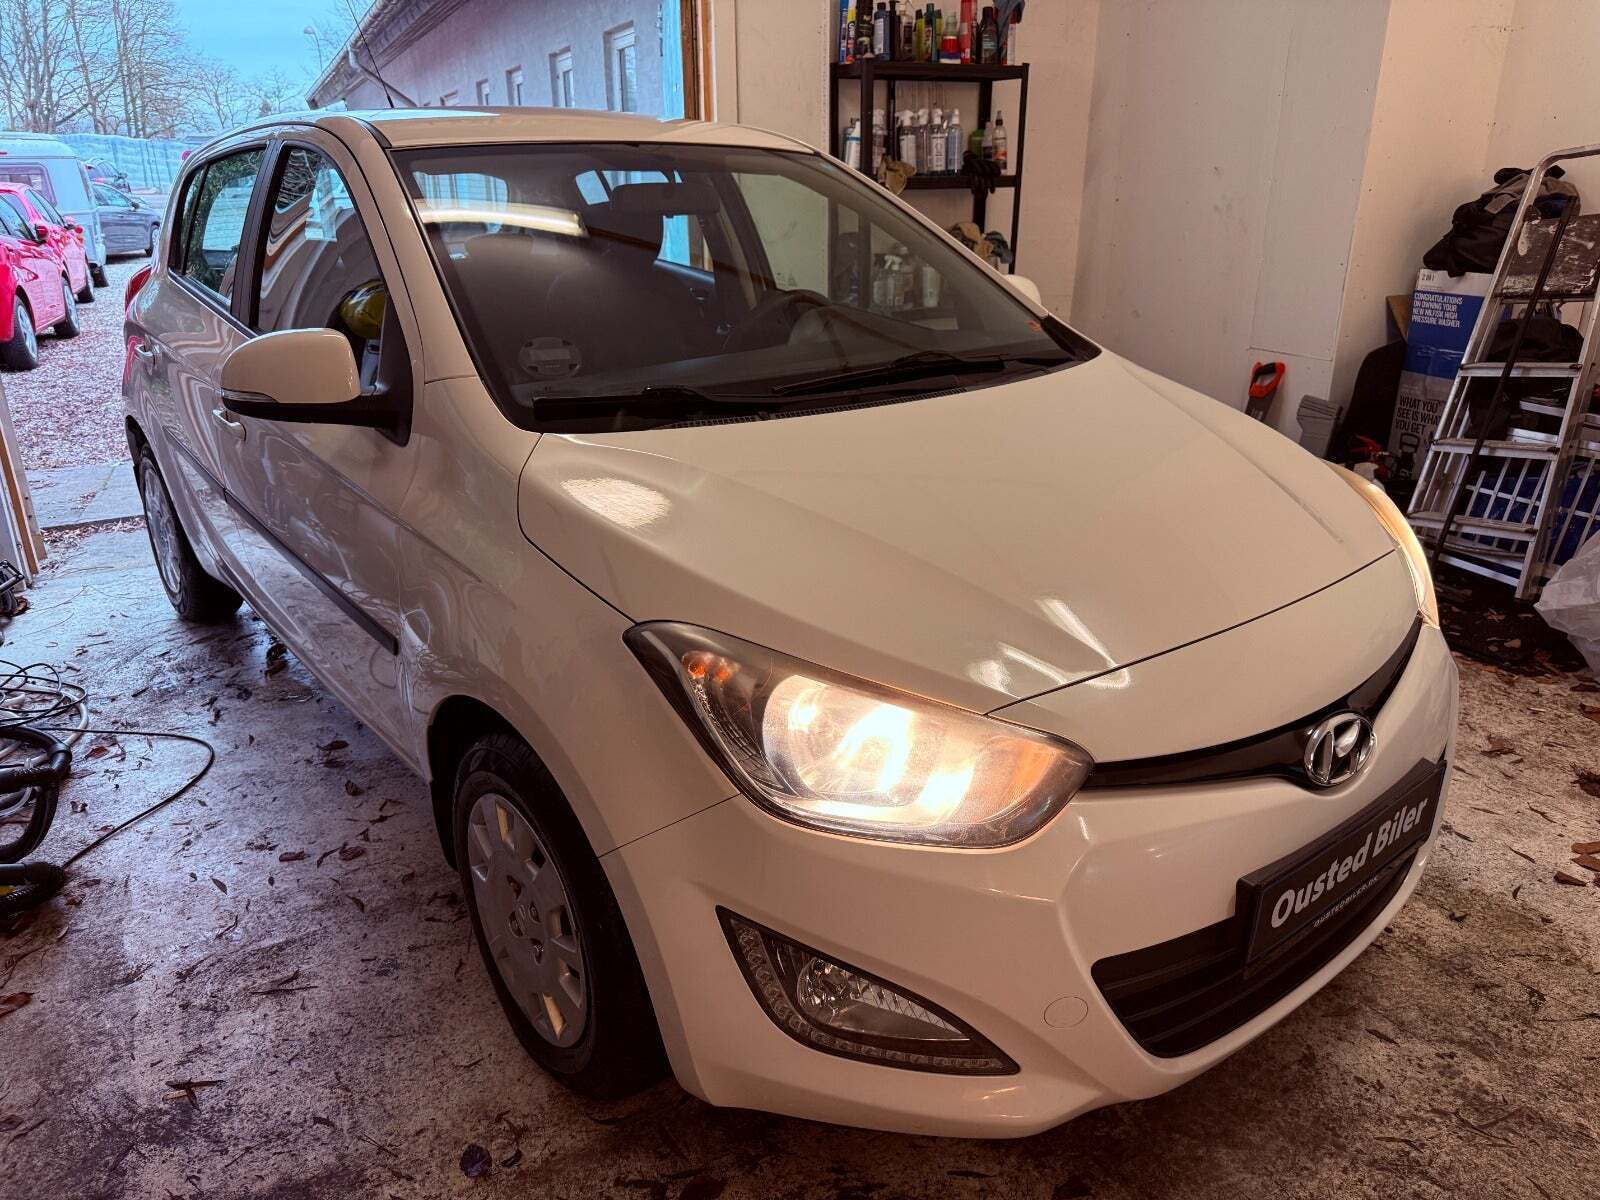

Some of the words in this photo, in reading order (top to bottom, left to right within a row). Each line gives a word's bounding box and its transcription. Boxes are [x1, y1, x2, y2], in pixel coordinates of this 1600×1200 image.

[1414, 292, 1462, 305] CONGRATULATIONS
[1413, 300, 1421, 308] ON
[1421, 301, 1442, 310] OWNING
[1443, 303, 1458, 312] YOUR
[1412, 307, 1424, 315] NEW
[1444, 311, 1458, 320] HIGH
[1411, 314, 1437, 325] PRESSURE
[1438, 318, 1460, 328] WASHER
[1400, 396, 1421, 410] WHAT
[1422, 400, 1439, 414] YOU
[1397, 407, 1412, 420] SEE
[1411, 410, 1420, 422] IS
[1395, 418, 1411, 431] YOU
[1411, 422, 1426, 435] GET
[1271, 831, 1373, 929] Ousted
[1372, 798, 1428, 858] Biler
